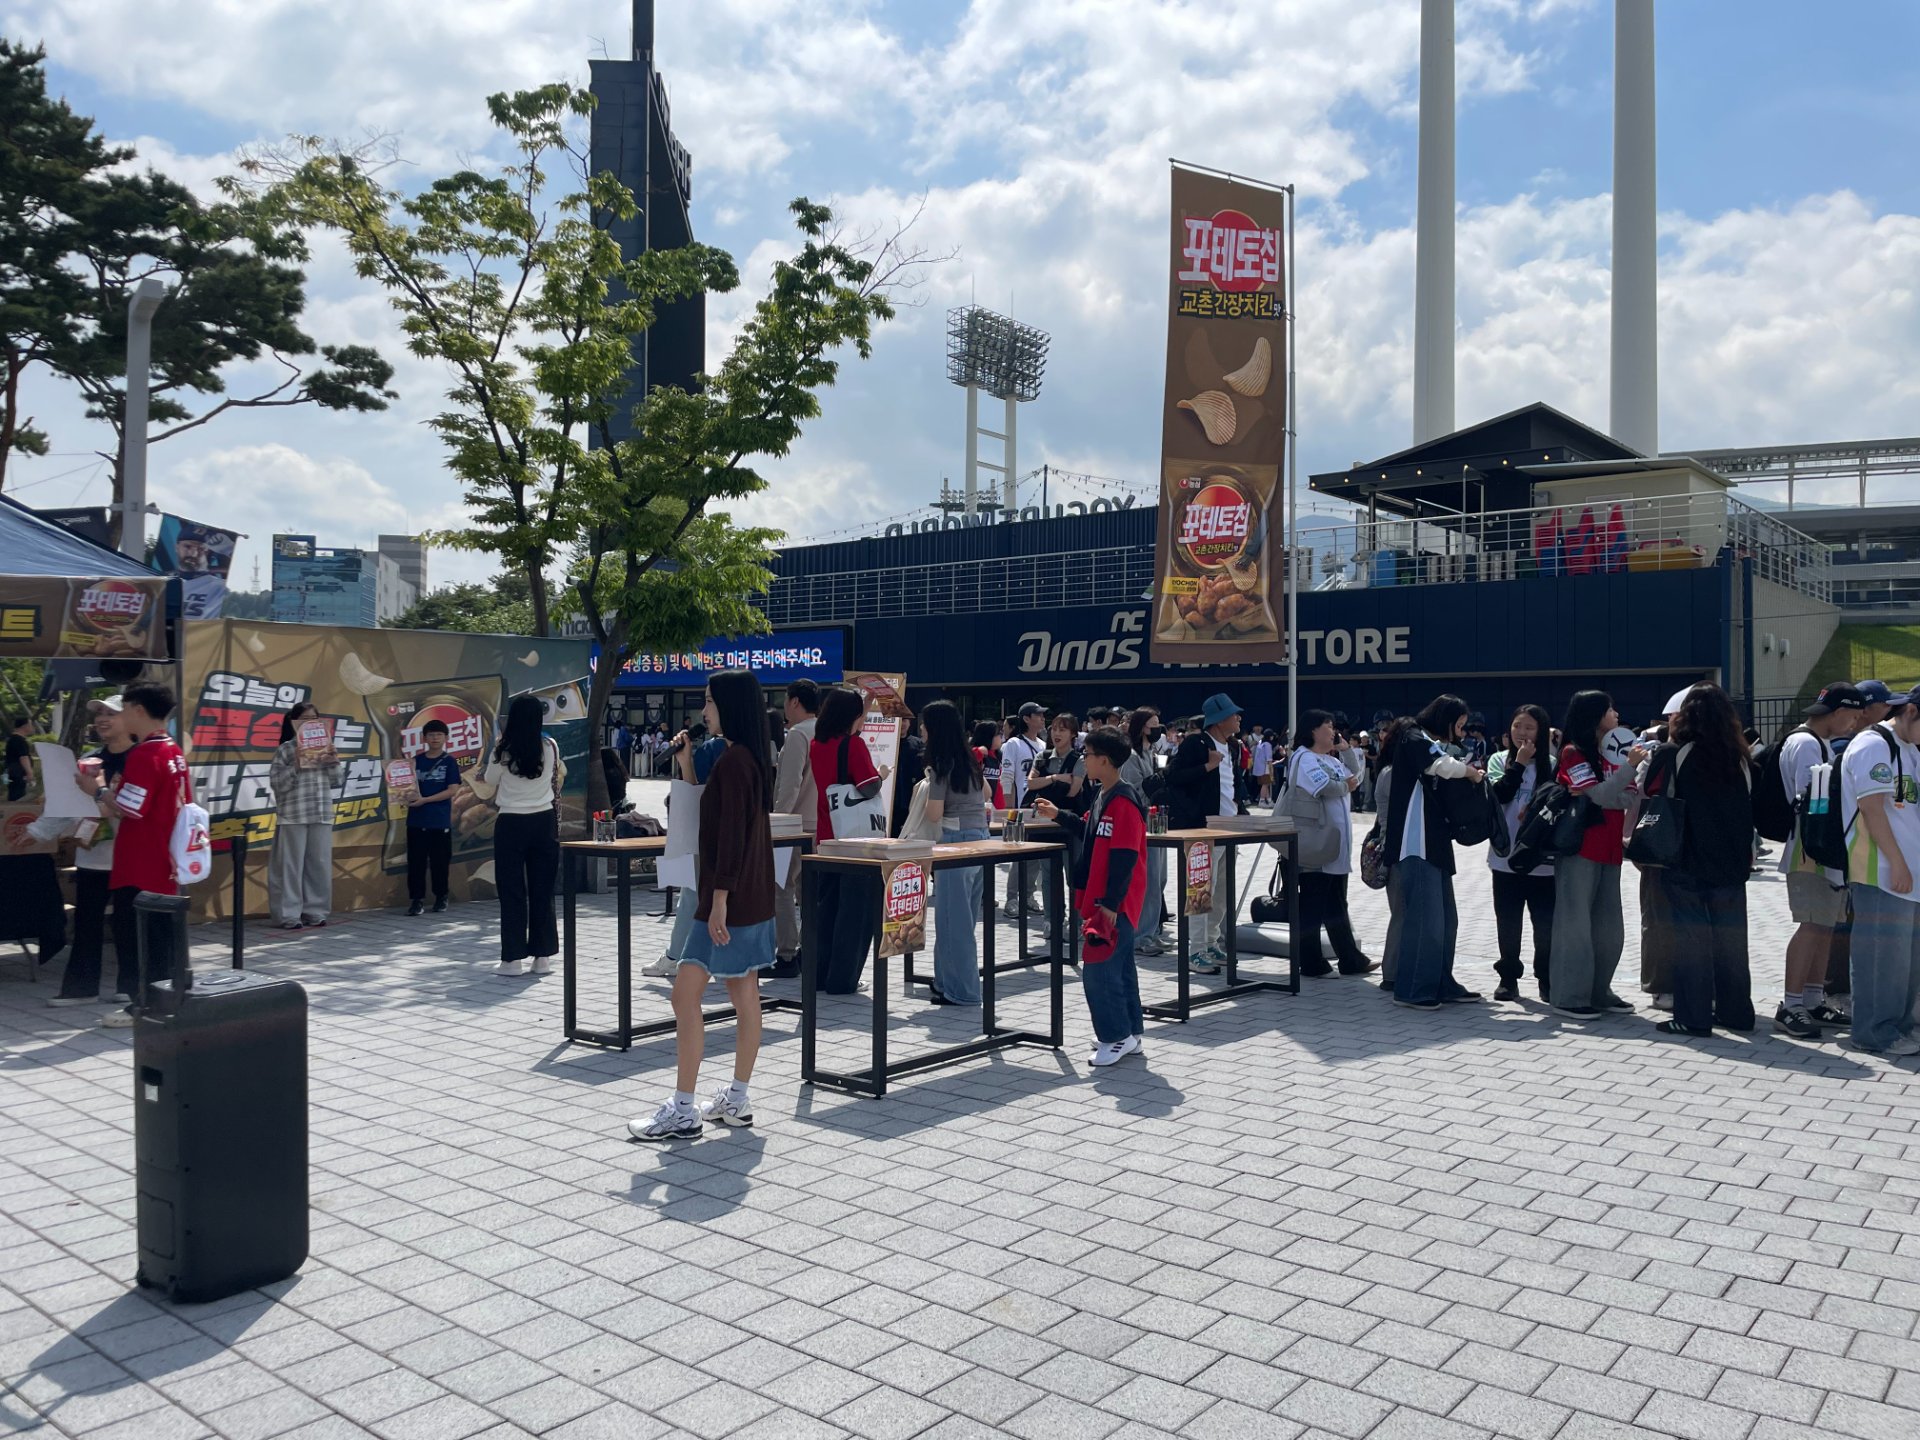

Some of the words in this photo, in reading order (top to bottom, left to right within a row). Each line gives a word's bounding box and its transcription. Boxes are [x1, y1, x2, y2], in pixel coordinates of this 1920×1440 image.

[1178, 218, 1280, 282] 포테토칩
[1178, 502, 1250, 544] 포테토칩
[77, 588, 147, 614] 포테토칩
[0, 609, 35, 638] 트
[669, 653, 681, 671] 및
[682, 651, 724, 671] 예매번호
[727, 650, 750, 668] 미리
[751, 648, 827, 668] 준비해주세요.
[203, 674, 305, 710] 오늘의
[192, 707, 367, 749] 결승는
[400, 714, 483, 759] 포토칩
